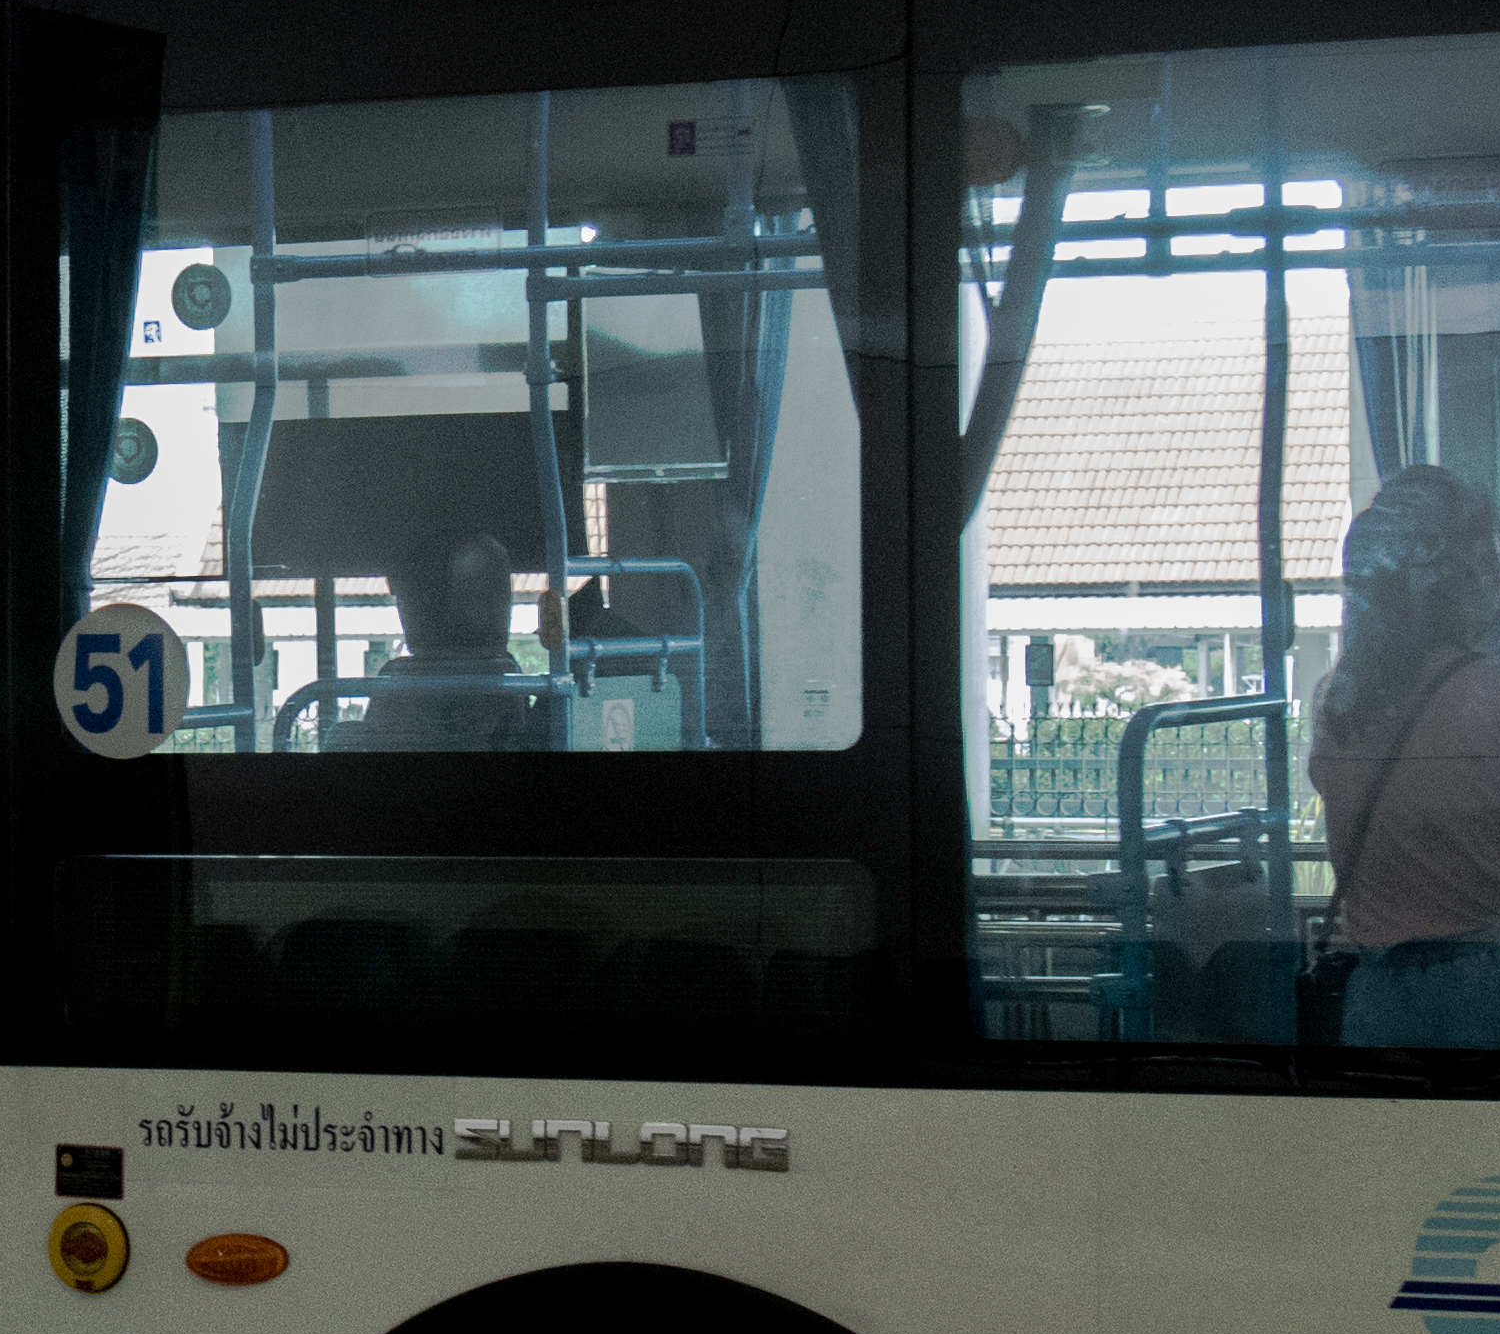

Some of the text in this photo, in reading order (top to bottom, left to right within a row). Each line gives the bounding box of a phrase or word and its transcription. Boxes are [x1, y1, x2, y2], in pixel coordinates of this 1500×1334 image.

[72, 632, 165, 734] 51
[139, 1103, 444, 1155] รถรับจ้างไม่ประจำทาง
[453, 1117, 791, 1172] SUNLONG
